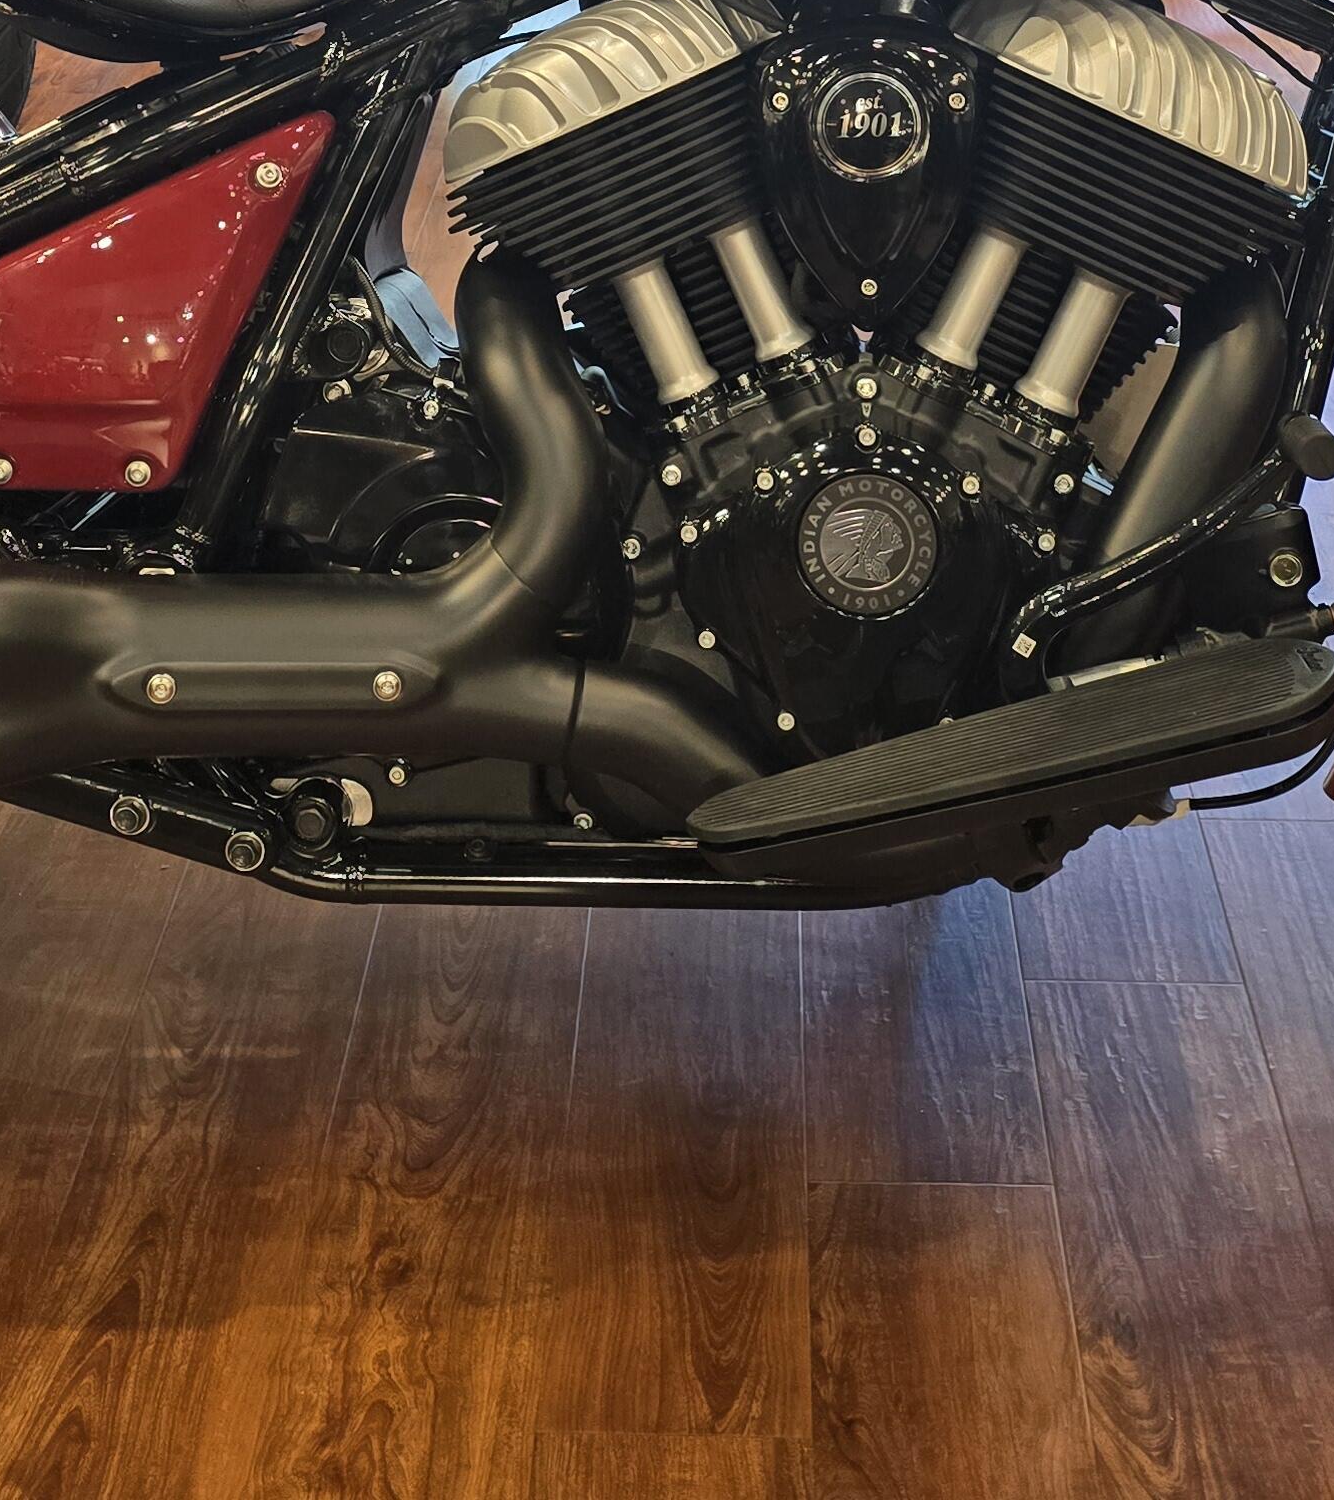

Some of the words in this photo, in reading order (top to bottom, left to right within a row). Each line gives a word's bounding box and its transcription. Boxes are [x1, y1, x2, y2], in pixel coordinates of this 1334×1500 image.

[855, 94, 884, 109] est.
[837, 111, 902, 138] 1901
[803, 497, 833, 584] INDIAN
[838, 479, 932, 587] MOTORCYCLE
[842, 593, 892, 609] 1901
